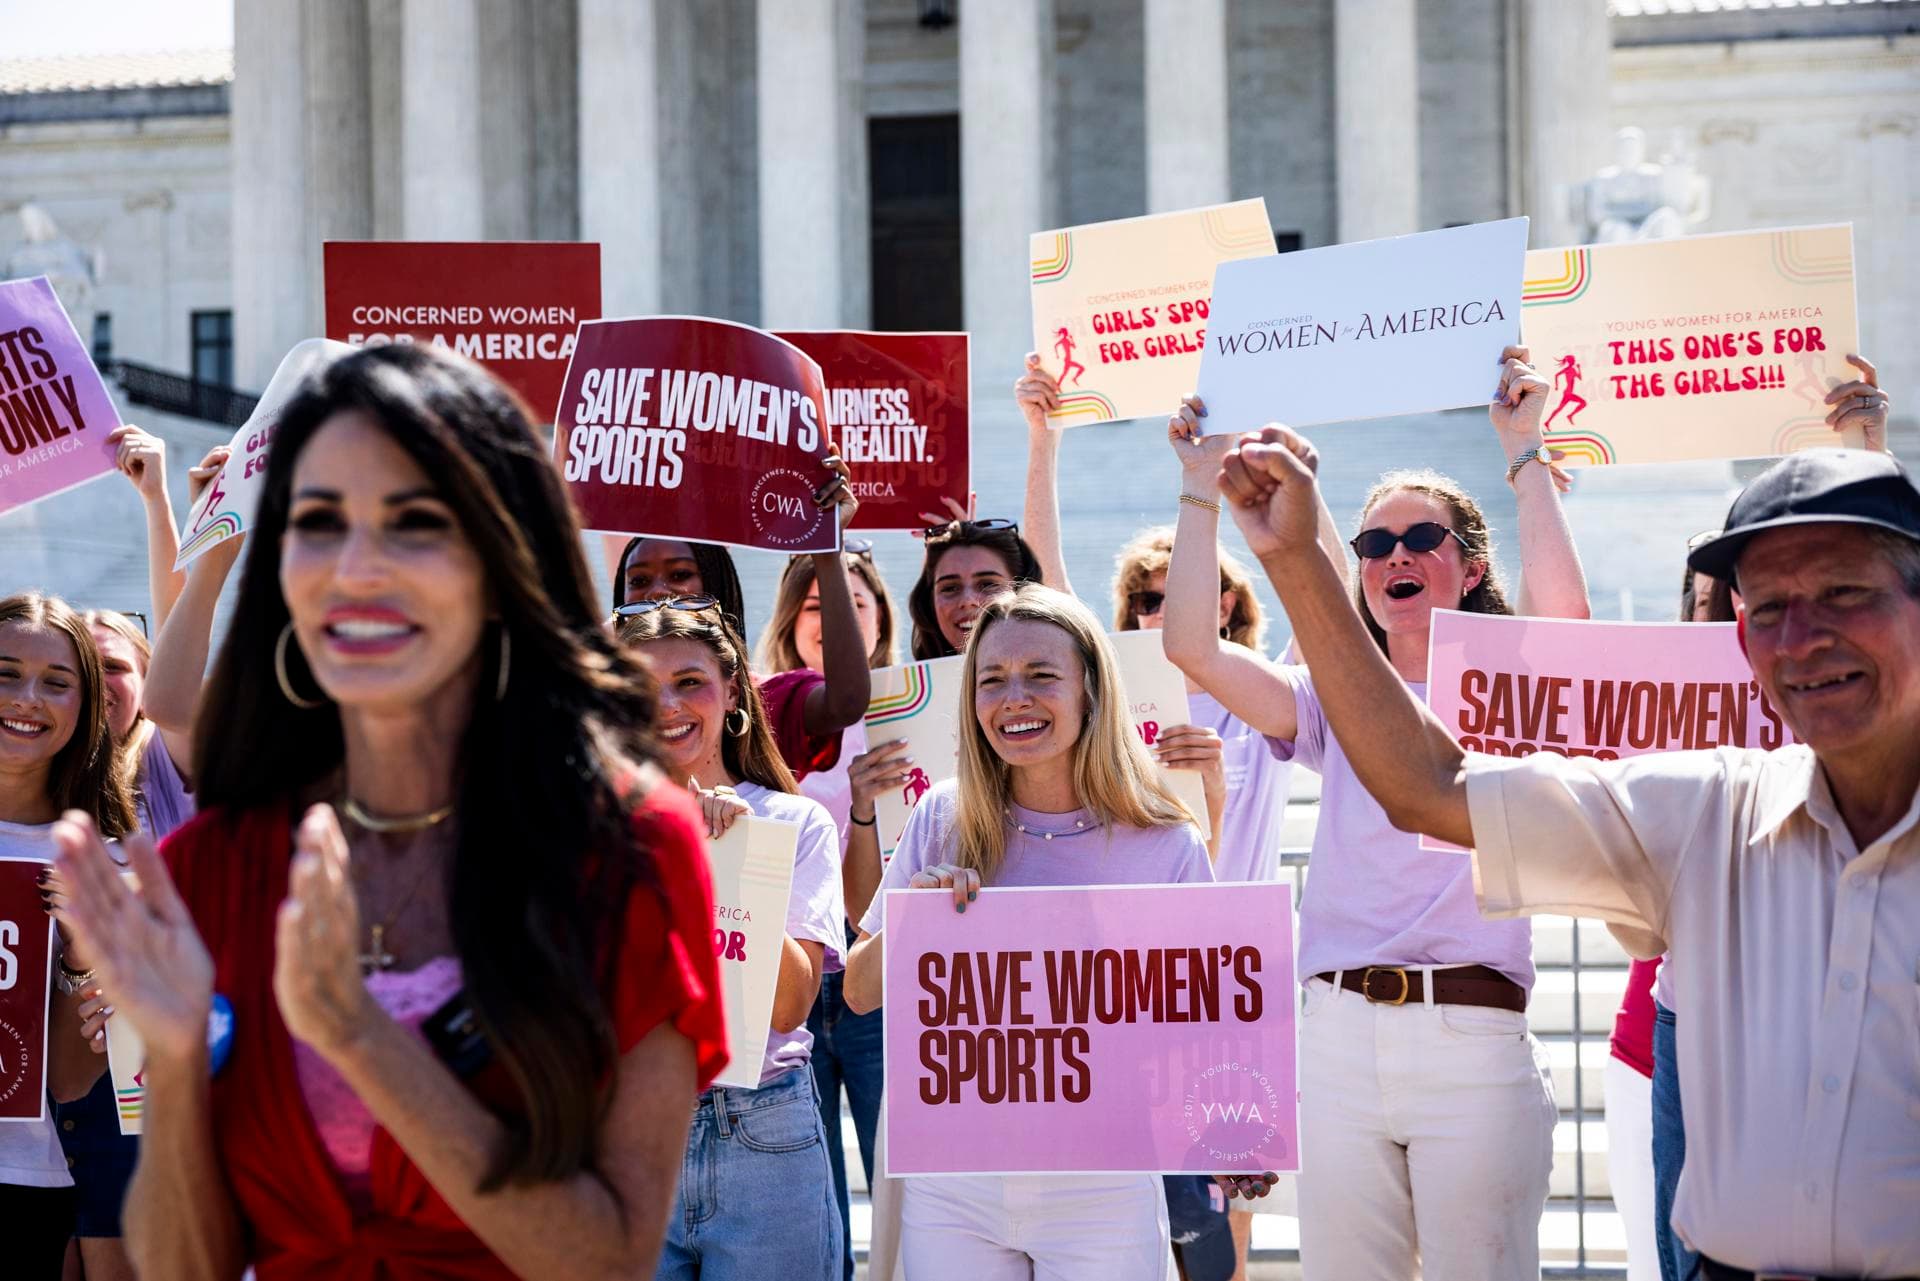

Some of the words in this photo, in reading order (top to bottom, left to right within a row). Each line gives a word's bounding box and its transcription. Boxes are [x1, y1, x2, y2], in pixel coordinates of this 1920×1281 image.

[1087, 289, 1146, 305] CONCERNED
[1149, 284, 1186, 296] WOMEN
[1188, 280, 1209, 290] FOR
[352, 306, 482, 325] CONCERNED
[489, 306, 575, 325] WOMEN
[1092, 307, 1159, 335] GIRLS'
[1167, 298, 1211, 325] SPO
[1217, 320, 1339, 357] WOMEN
[1341, 325, 1354, 336] for
[1354, 299, 1505, 341] AMERICA
[1247, 314, 1313, 330] CONCERNED
[1606, 319, 1657, 333] YOUNG
[1663, 314, 1720, 328] WOMEN
[1726, 311, 1753, 324] FOR
[1758, 306, 1824, 321] AMERICA
[432, 333, 577, 360] AMERICA
[1099, 340, 1139, 364] FOR
[1144, 329, 1206, 358] GIRLS
[1608, 337, 1675, 366] THIS
[1684, 331, 1764, 361] ONE'S
[1773, 326, 1826, 354] FOR
[1610, 372, 1665, 400] THE
[1674, 363, 1786, 396] GIRLS!!!
[0, 374, 86, 456] ONLY
[575, 367, 655, 426] SAVE
[659, 368, 819, 454] WOMEN'S
[17, 436, 85, 472] AMERICA
[564, 424, 687, 490] SPORTS
[842, 425, 934, 463] REALITY.
[751, 468, 785, 503] CONCERNED
[789, 522, 820, 544] AMERICA
[763, 491, 807, 521] CWA
[1459, 668, 1572, 744] SAVE
[1582, 678, 1784, 752] WOMEN'S
[1136, 720, 1159, 746] R
[917, 951, 1034, 1028] SAVE
[1043, 944, 1263, 1025] WOMEN'S
[0, 1019, 21, 1040] MEN
[20, 1047, 28, 1067] FOR
[919, 1026, 1091, 1106] SPORTS
[1201, 1062, 1240, 1080] YOUNG
[0, 1076, 23, 1102] AMER
[1251, 1068, 1279, 1109] WOMEN
[1200, 1102, 1264, 1124] YWA
[1262, 1122, 1278, 1144] FOR
[1209, 1147, 1255, 1162] AMERICA
